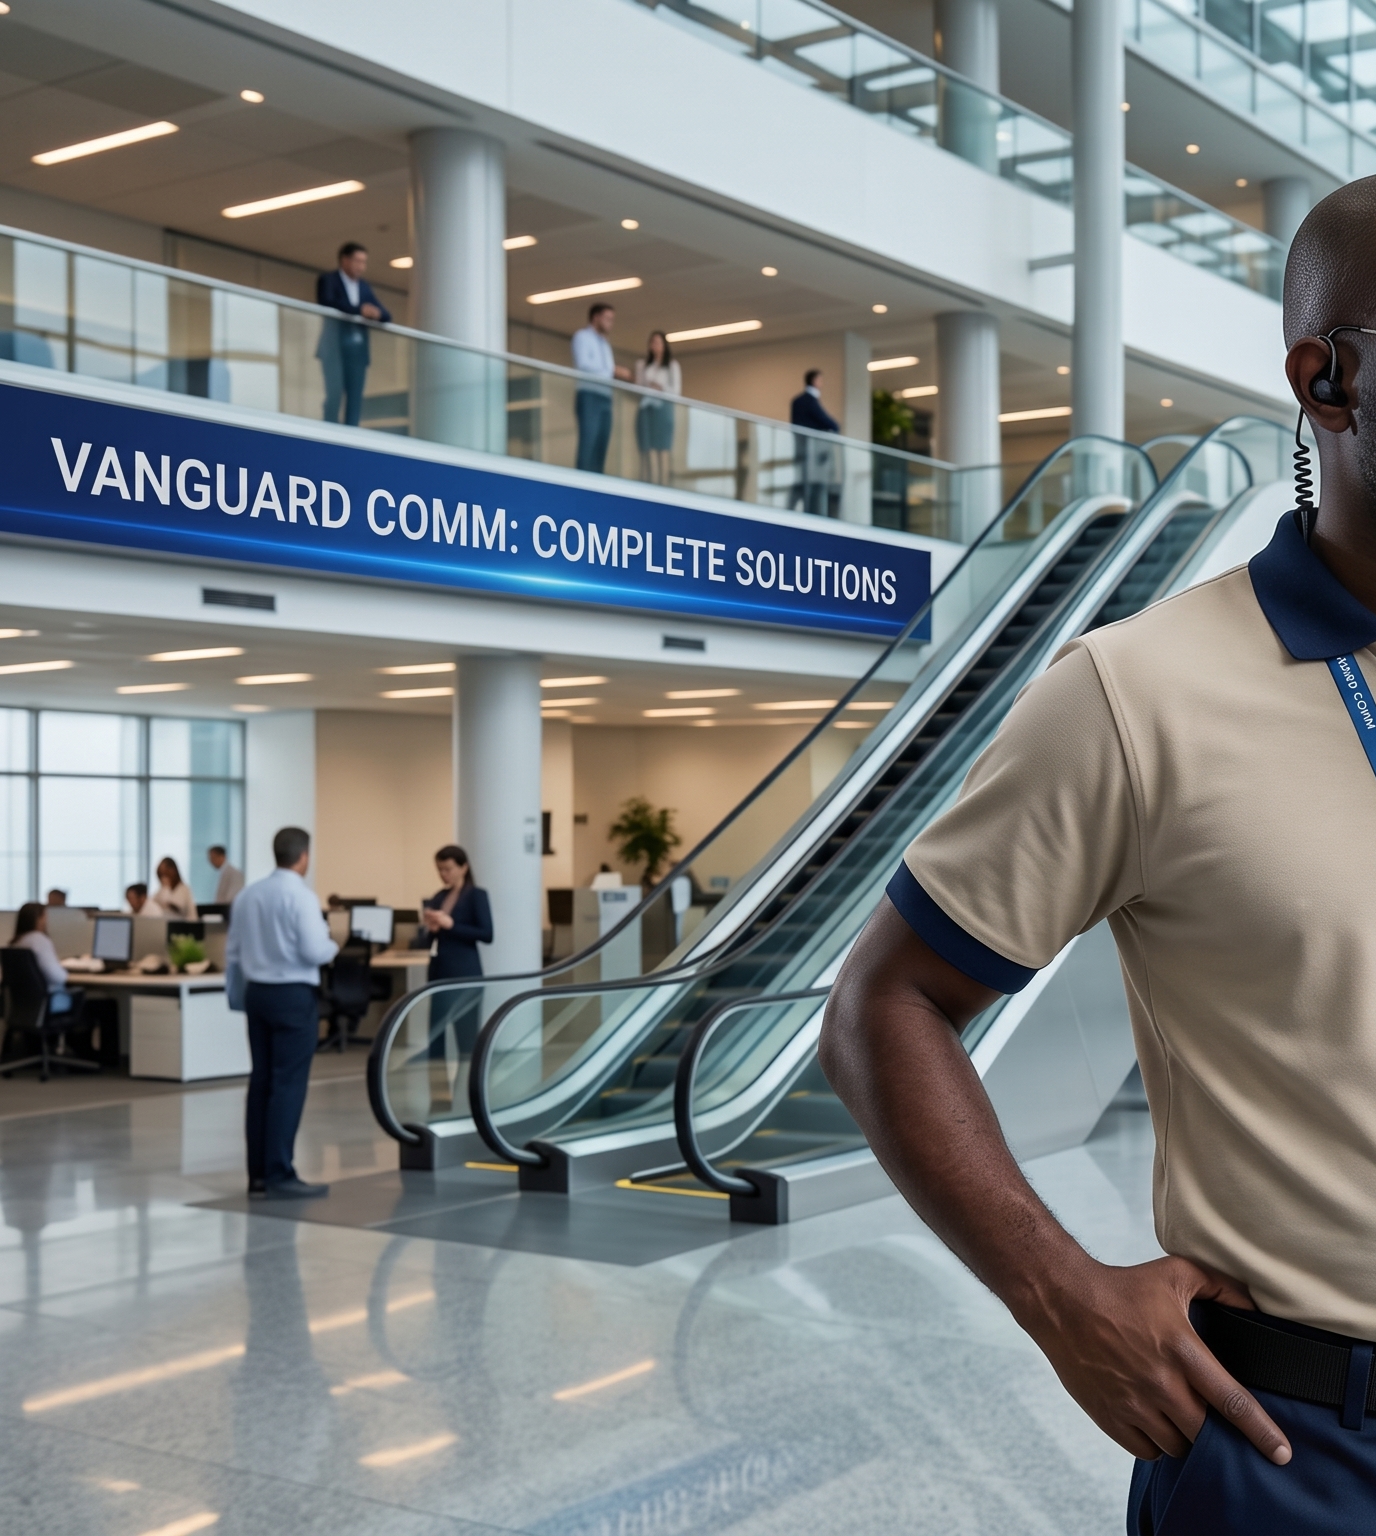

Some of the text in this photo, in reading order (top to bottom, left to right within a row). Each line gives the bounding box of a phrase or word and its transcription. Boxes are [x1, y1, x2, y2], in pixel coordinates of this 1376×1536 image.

[50, 437, 898, 606] VANGUARD COMM: COMPLETE SOLUTIONS
